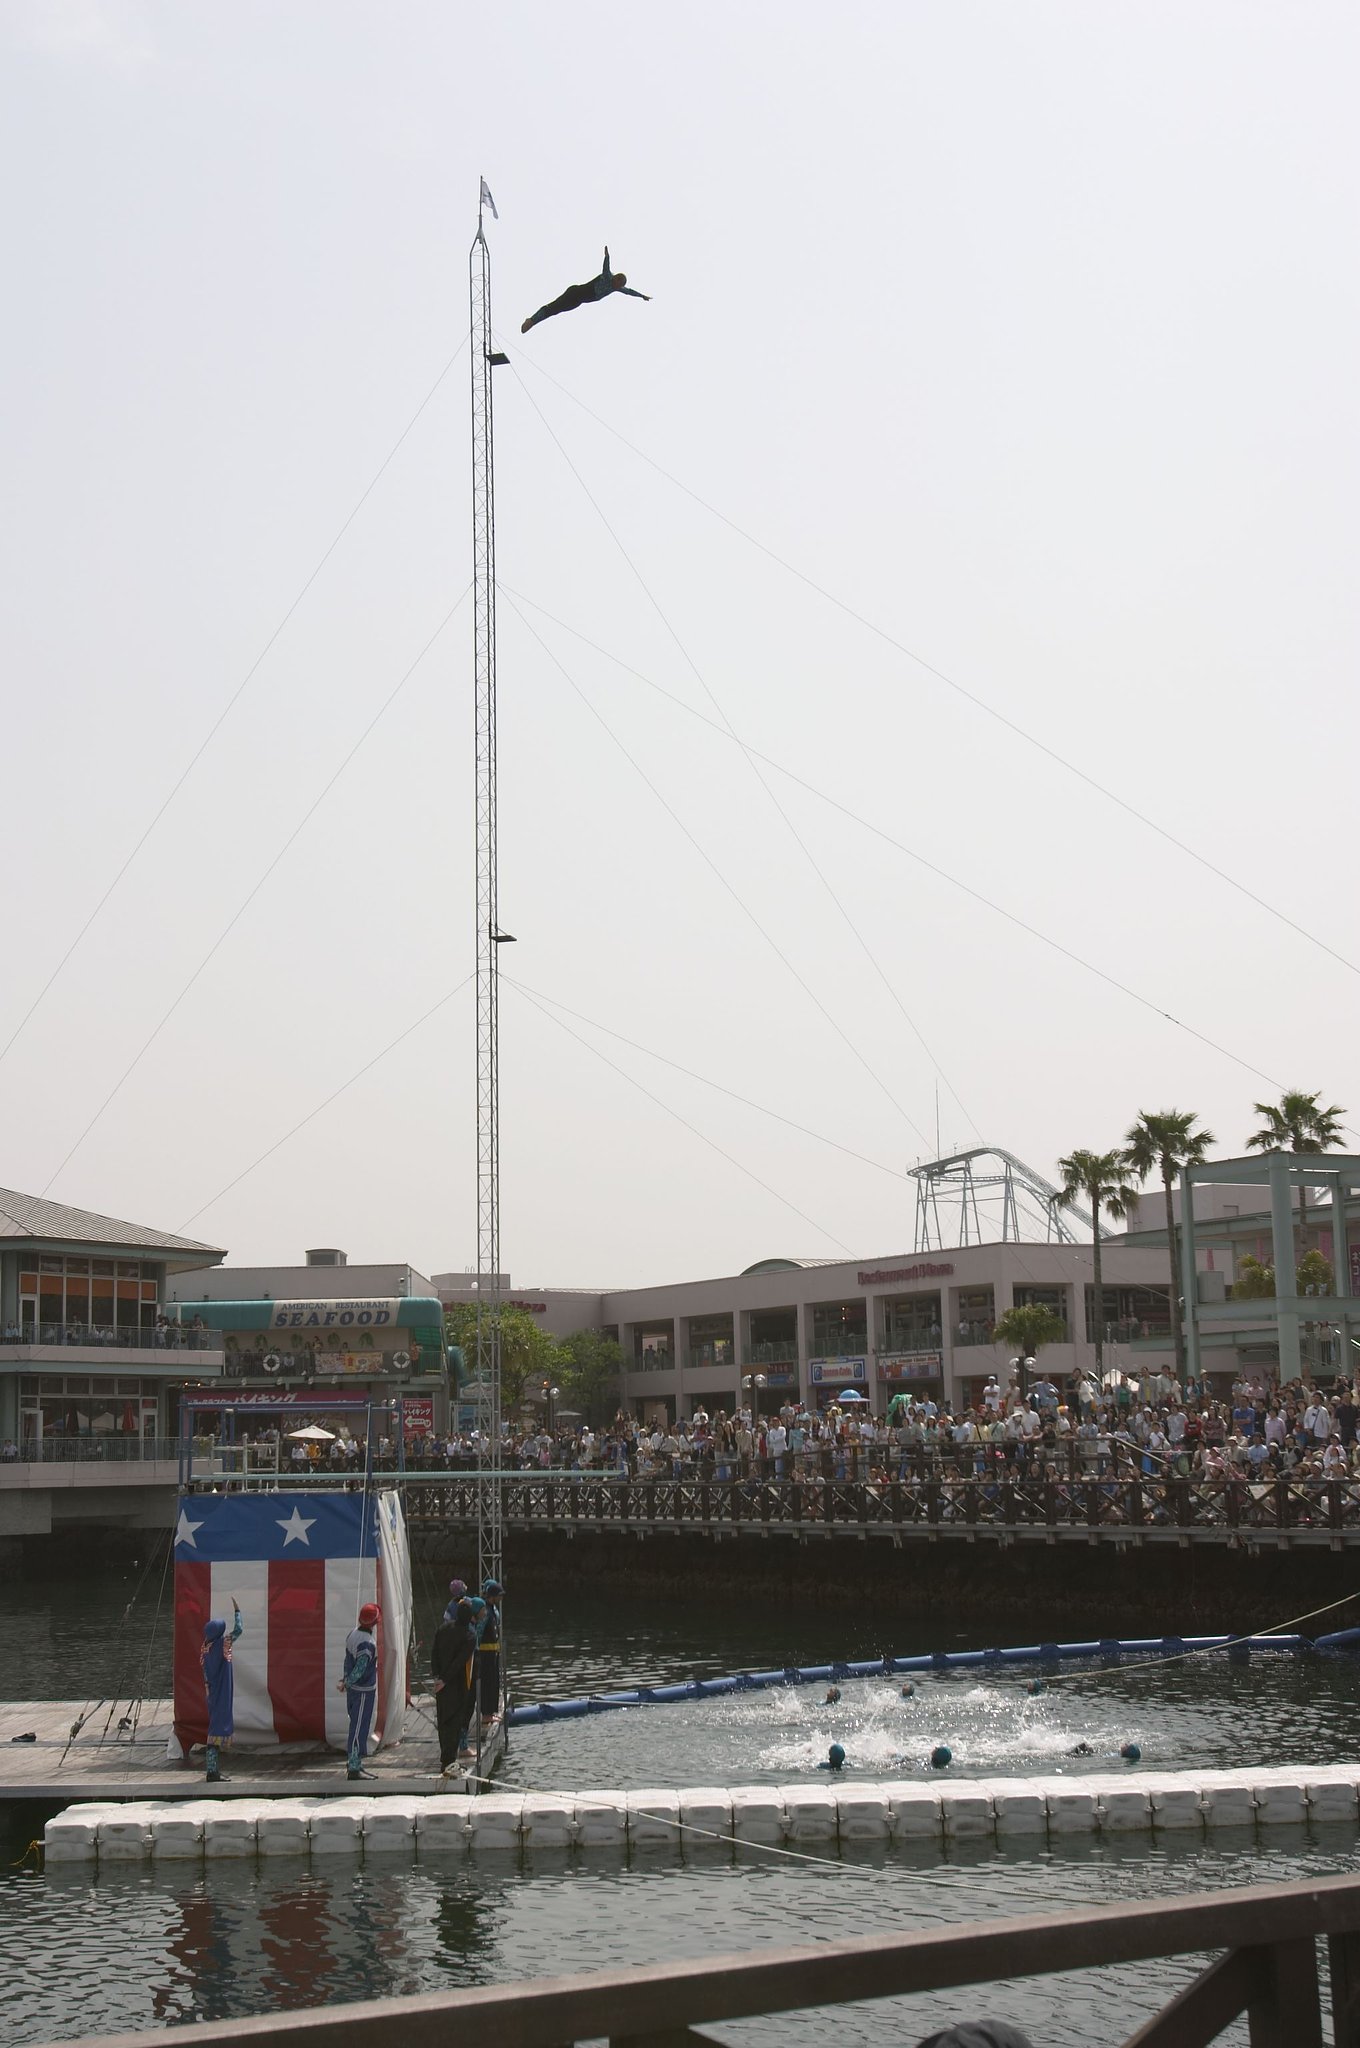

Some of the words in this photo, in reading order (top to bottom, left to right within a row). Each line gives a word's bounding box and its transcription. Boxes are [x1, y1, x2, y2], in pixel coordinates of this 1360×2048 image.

[281, 1303, 328, 1311] AMERICAN
[335, 1301, 390, 1310] RESTAURANT
[275, 1311, 390, 1327] SEAFOOD
